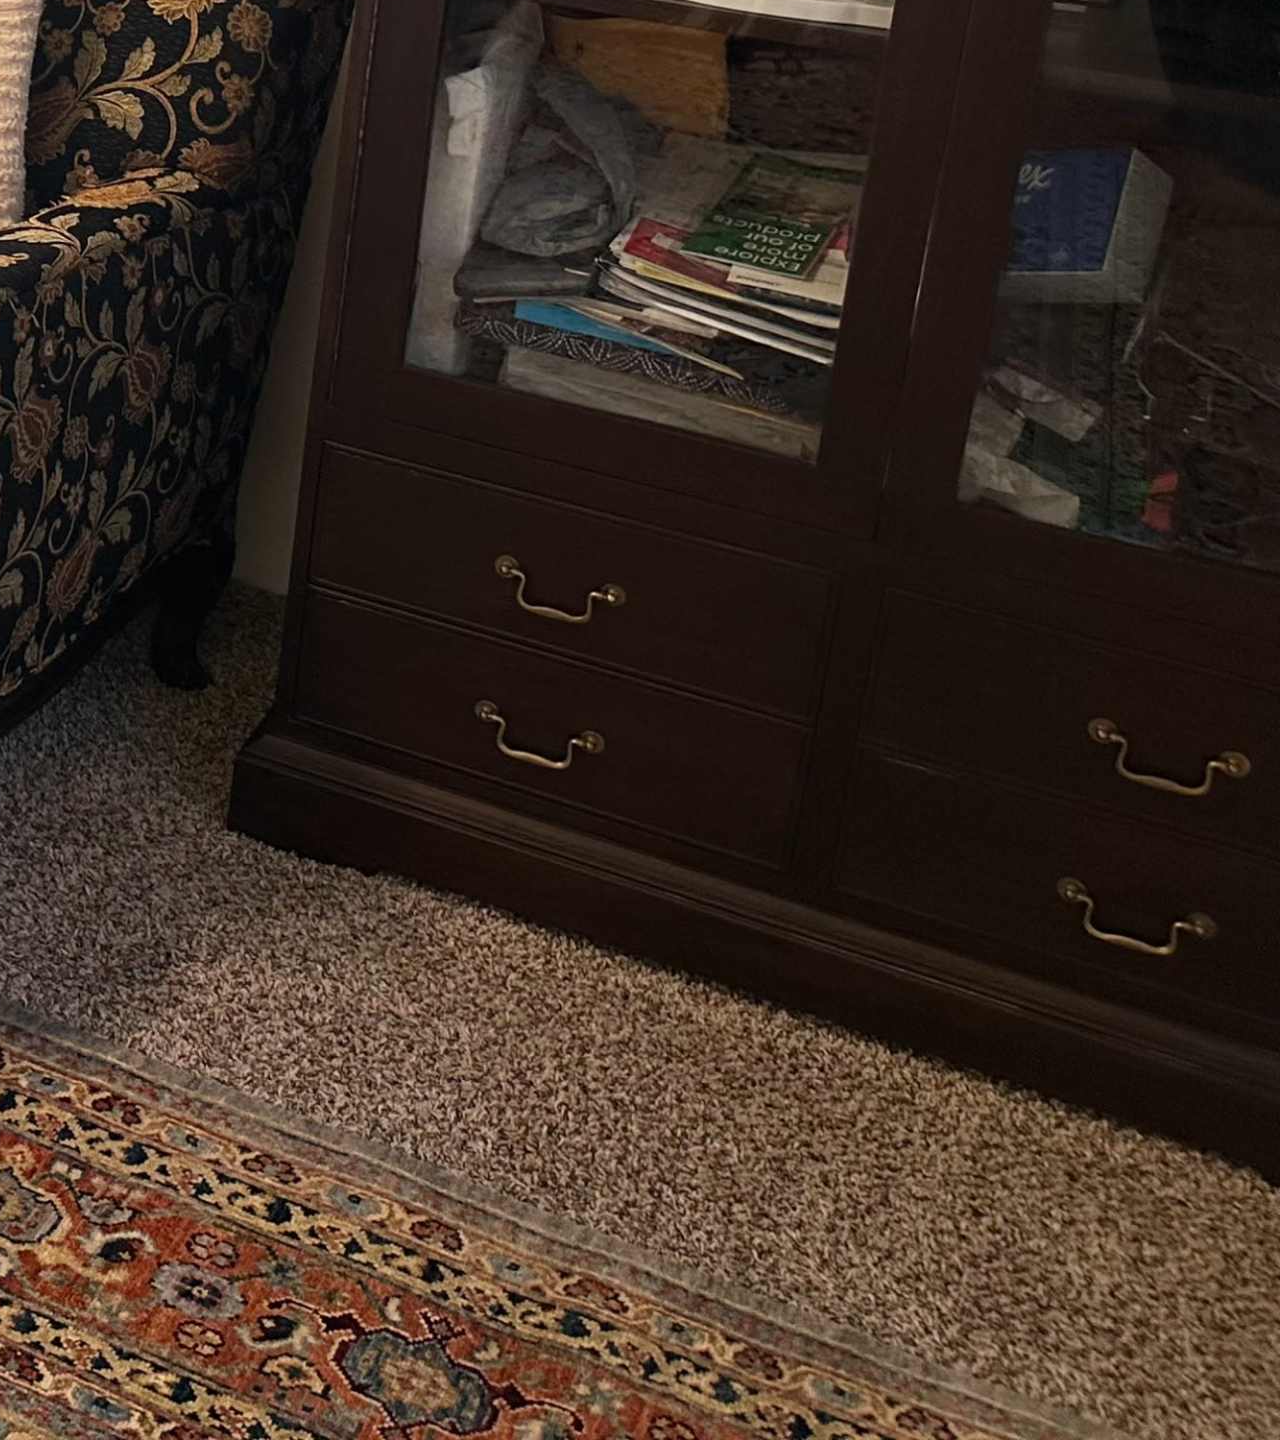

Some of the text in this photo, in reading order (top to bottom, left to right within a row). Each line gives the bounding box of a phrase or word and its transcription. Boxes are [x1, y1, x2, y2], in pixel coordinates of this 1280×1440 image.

[712, 214, 822, 243] products
[743, 241, 808, 261] more
[744, 232, 814, 252] of our
[714, 245, 801, 272] Explore
